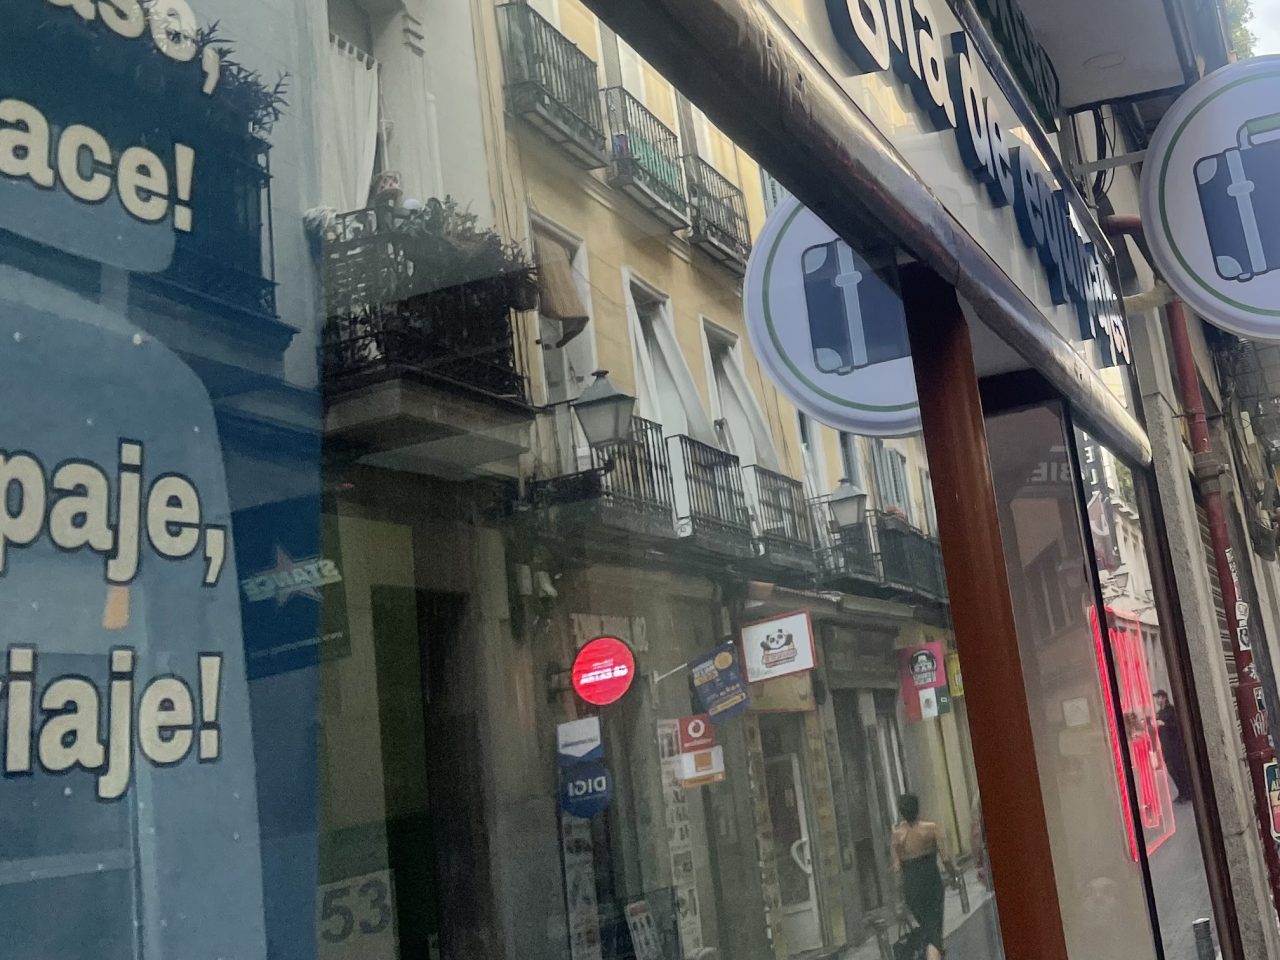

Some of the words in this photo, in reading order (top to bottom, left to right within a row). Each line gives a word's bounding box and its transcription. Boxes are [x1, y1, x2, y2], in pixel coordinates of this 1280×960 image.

[958, 30, 1016, 208] de
[0, 647, 224, 801] iaje!
[320, 880, 391, 944] 53
